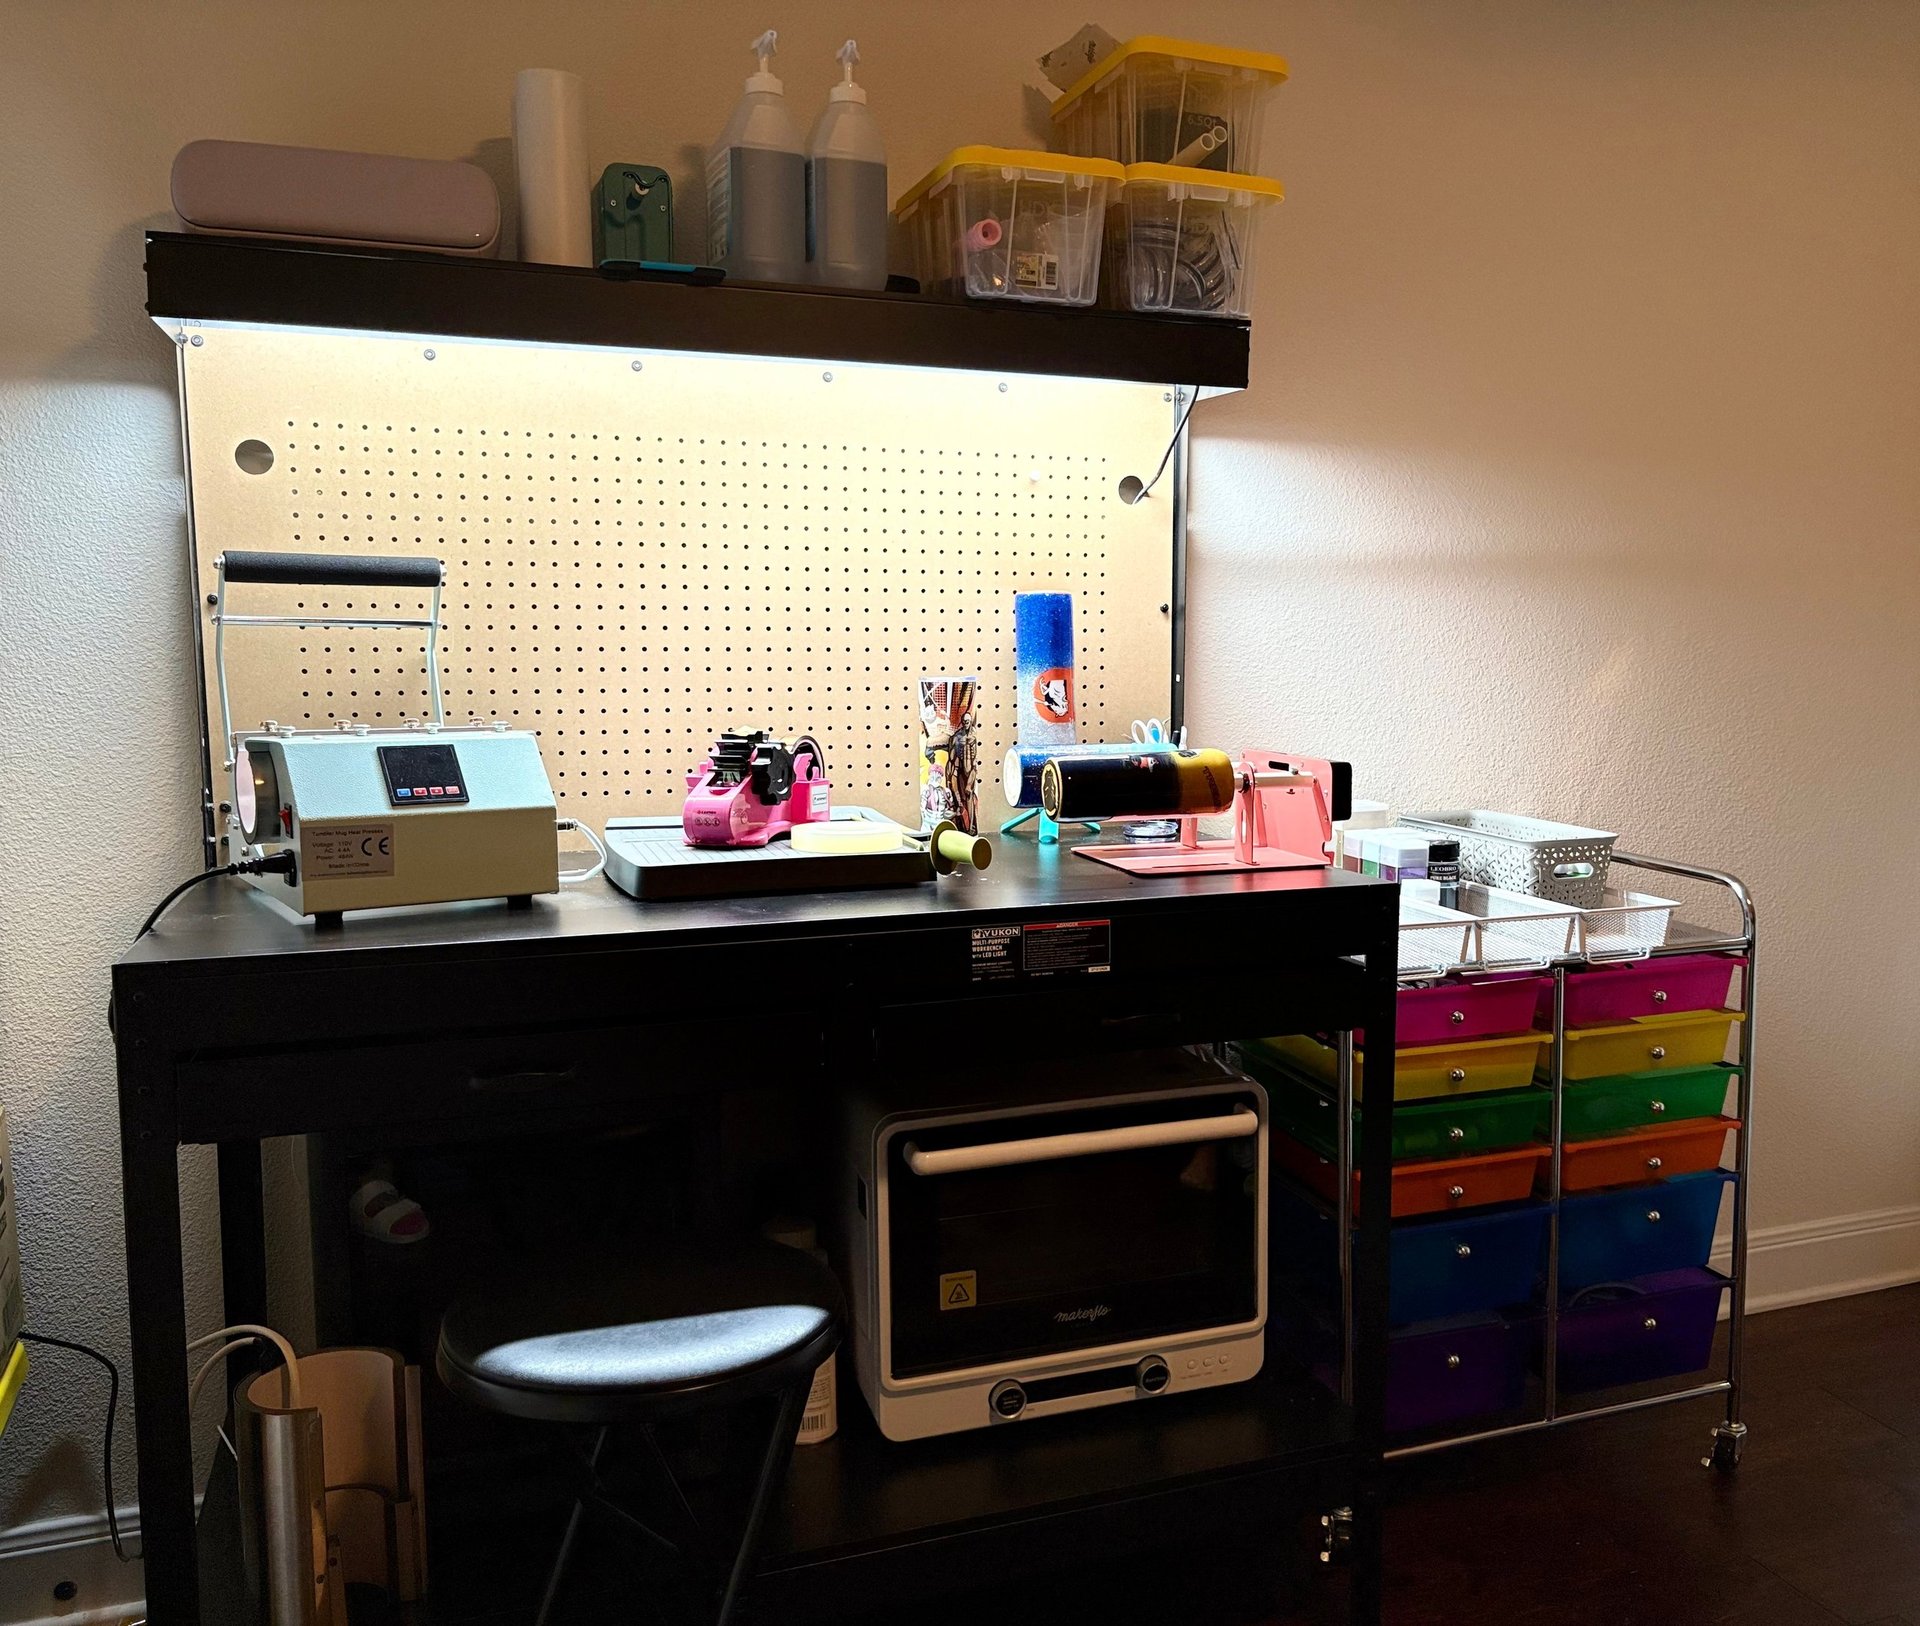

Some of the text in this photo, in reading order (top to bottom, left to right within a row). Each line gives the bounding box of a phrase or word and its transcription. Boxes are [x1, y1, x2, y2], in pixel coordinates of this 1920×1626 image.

[984, 928, 1019, 937] YUKON
[972, 938, 1011, 946] MULTI-PURPOSE
[993, 950, 1007, 958] LIGHT
